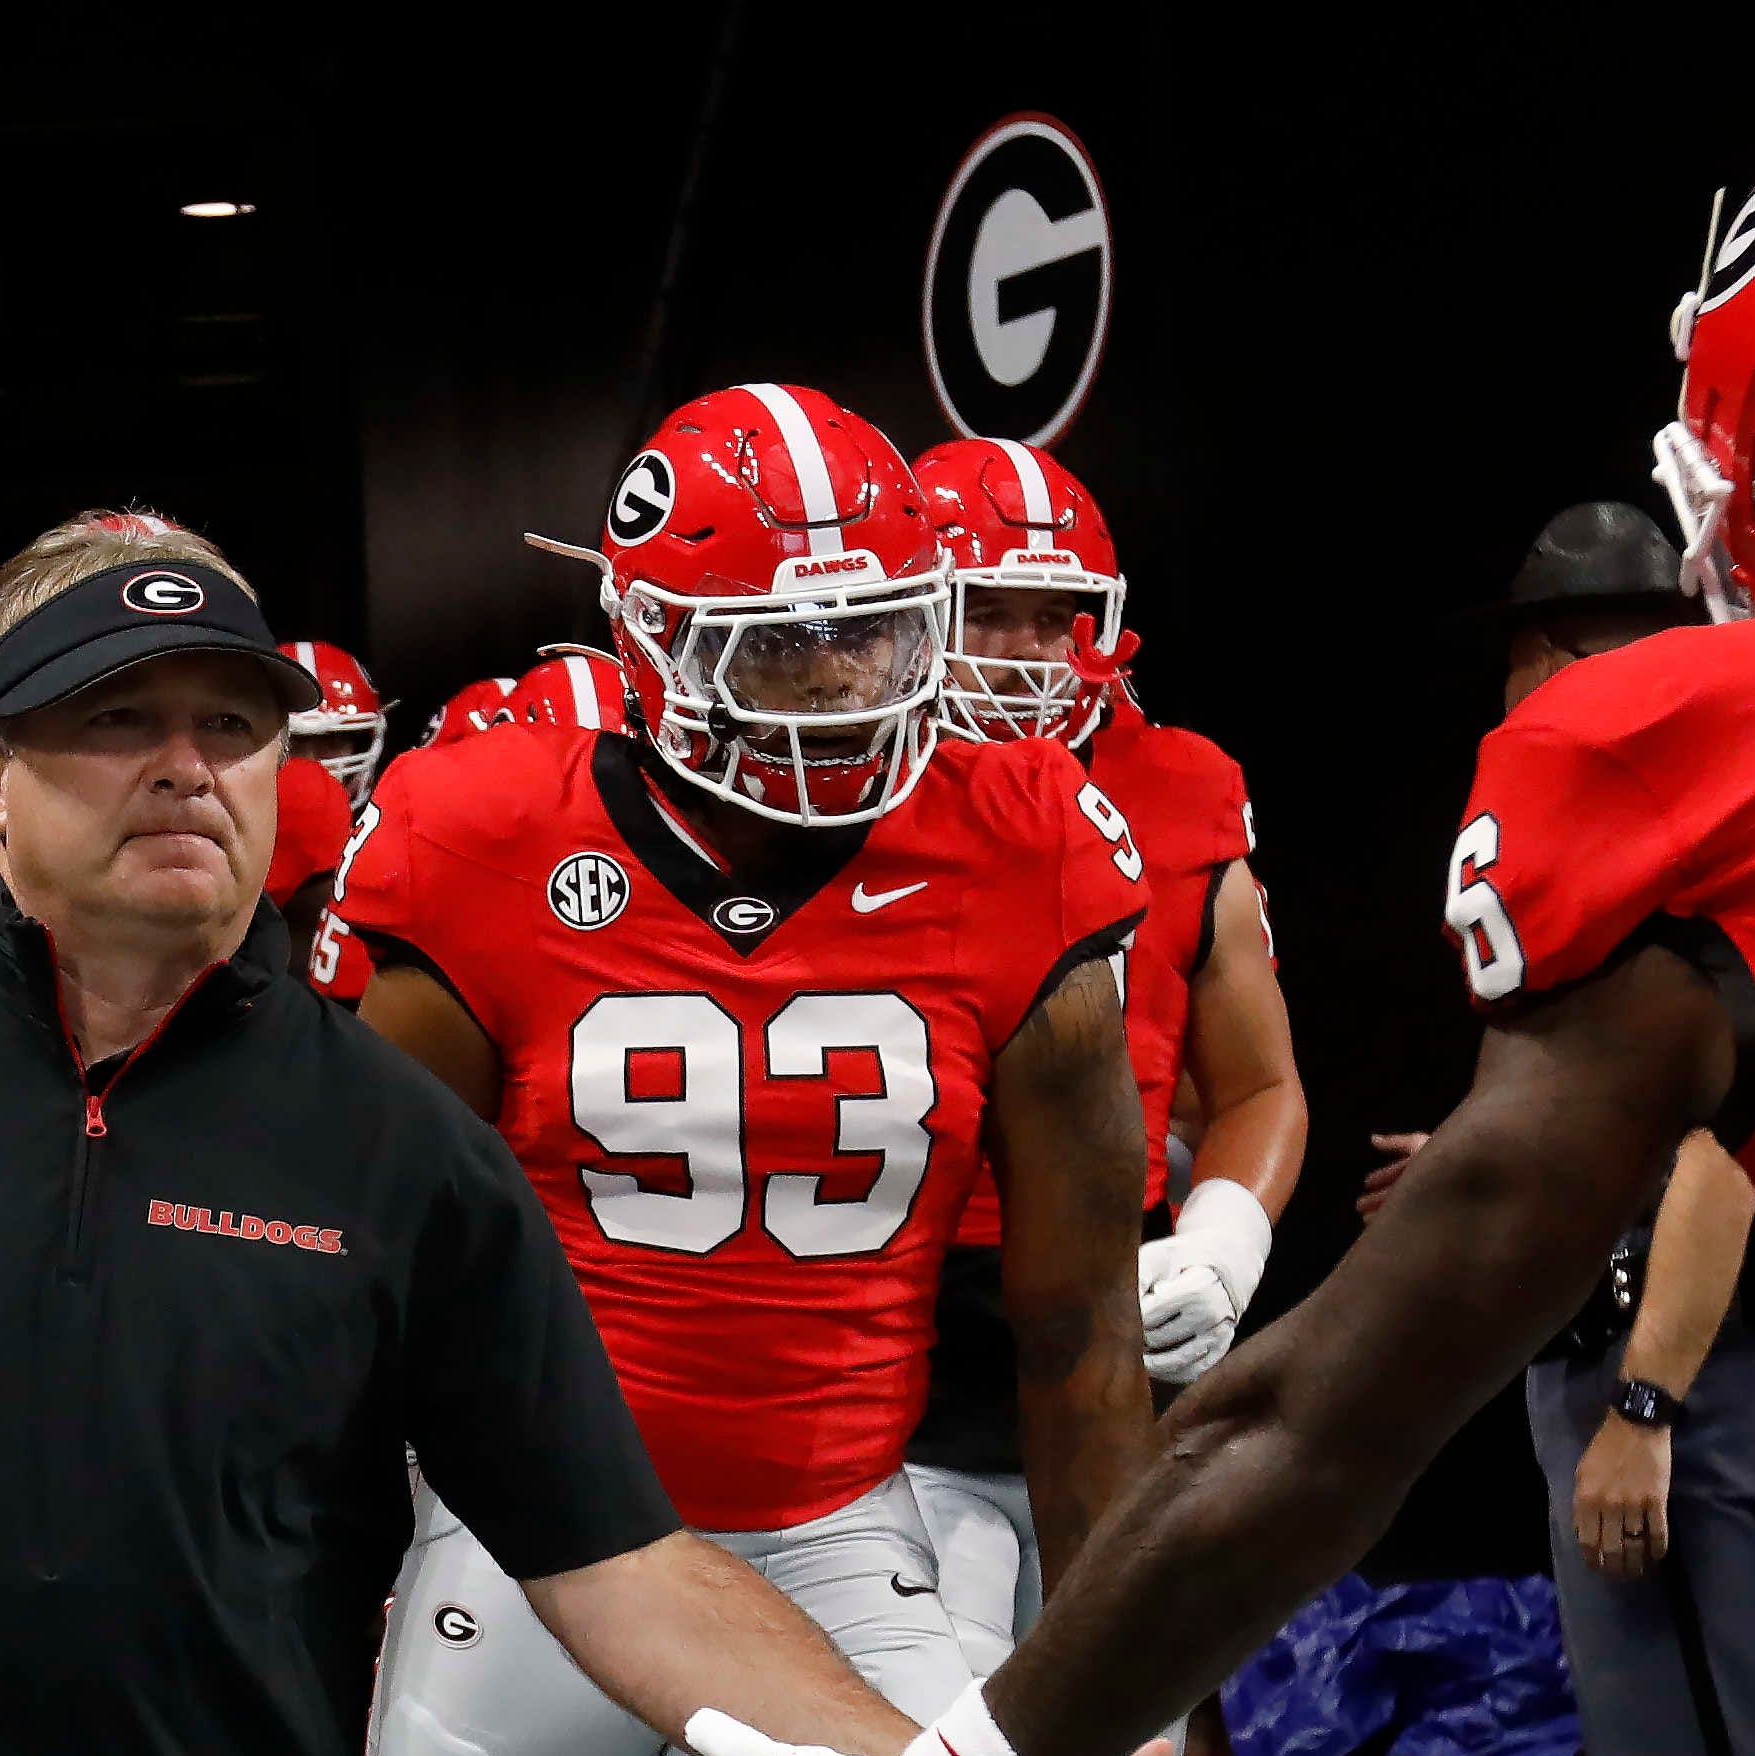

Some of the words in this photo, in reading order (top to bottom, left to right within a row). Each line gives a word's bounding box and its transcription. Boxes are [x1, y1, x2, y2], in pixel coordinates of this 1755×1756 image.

[794, 556, 869, 579] DAWGS
[1076, 781, 1144, 882] 9
[554, 857, 622, 923] SEC
[1445, 811, 1525, 1001] 6
[570, 990, 936, 1261] 93
[147, 1199, 344, 1255] BULLDOGS
